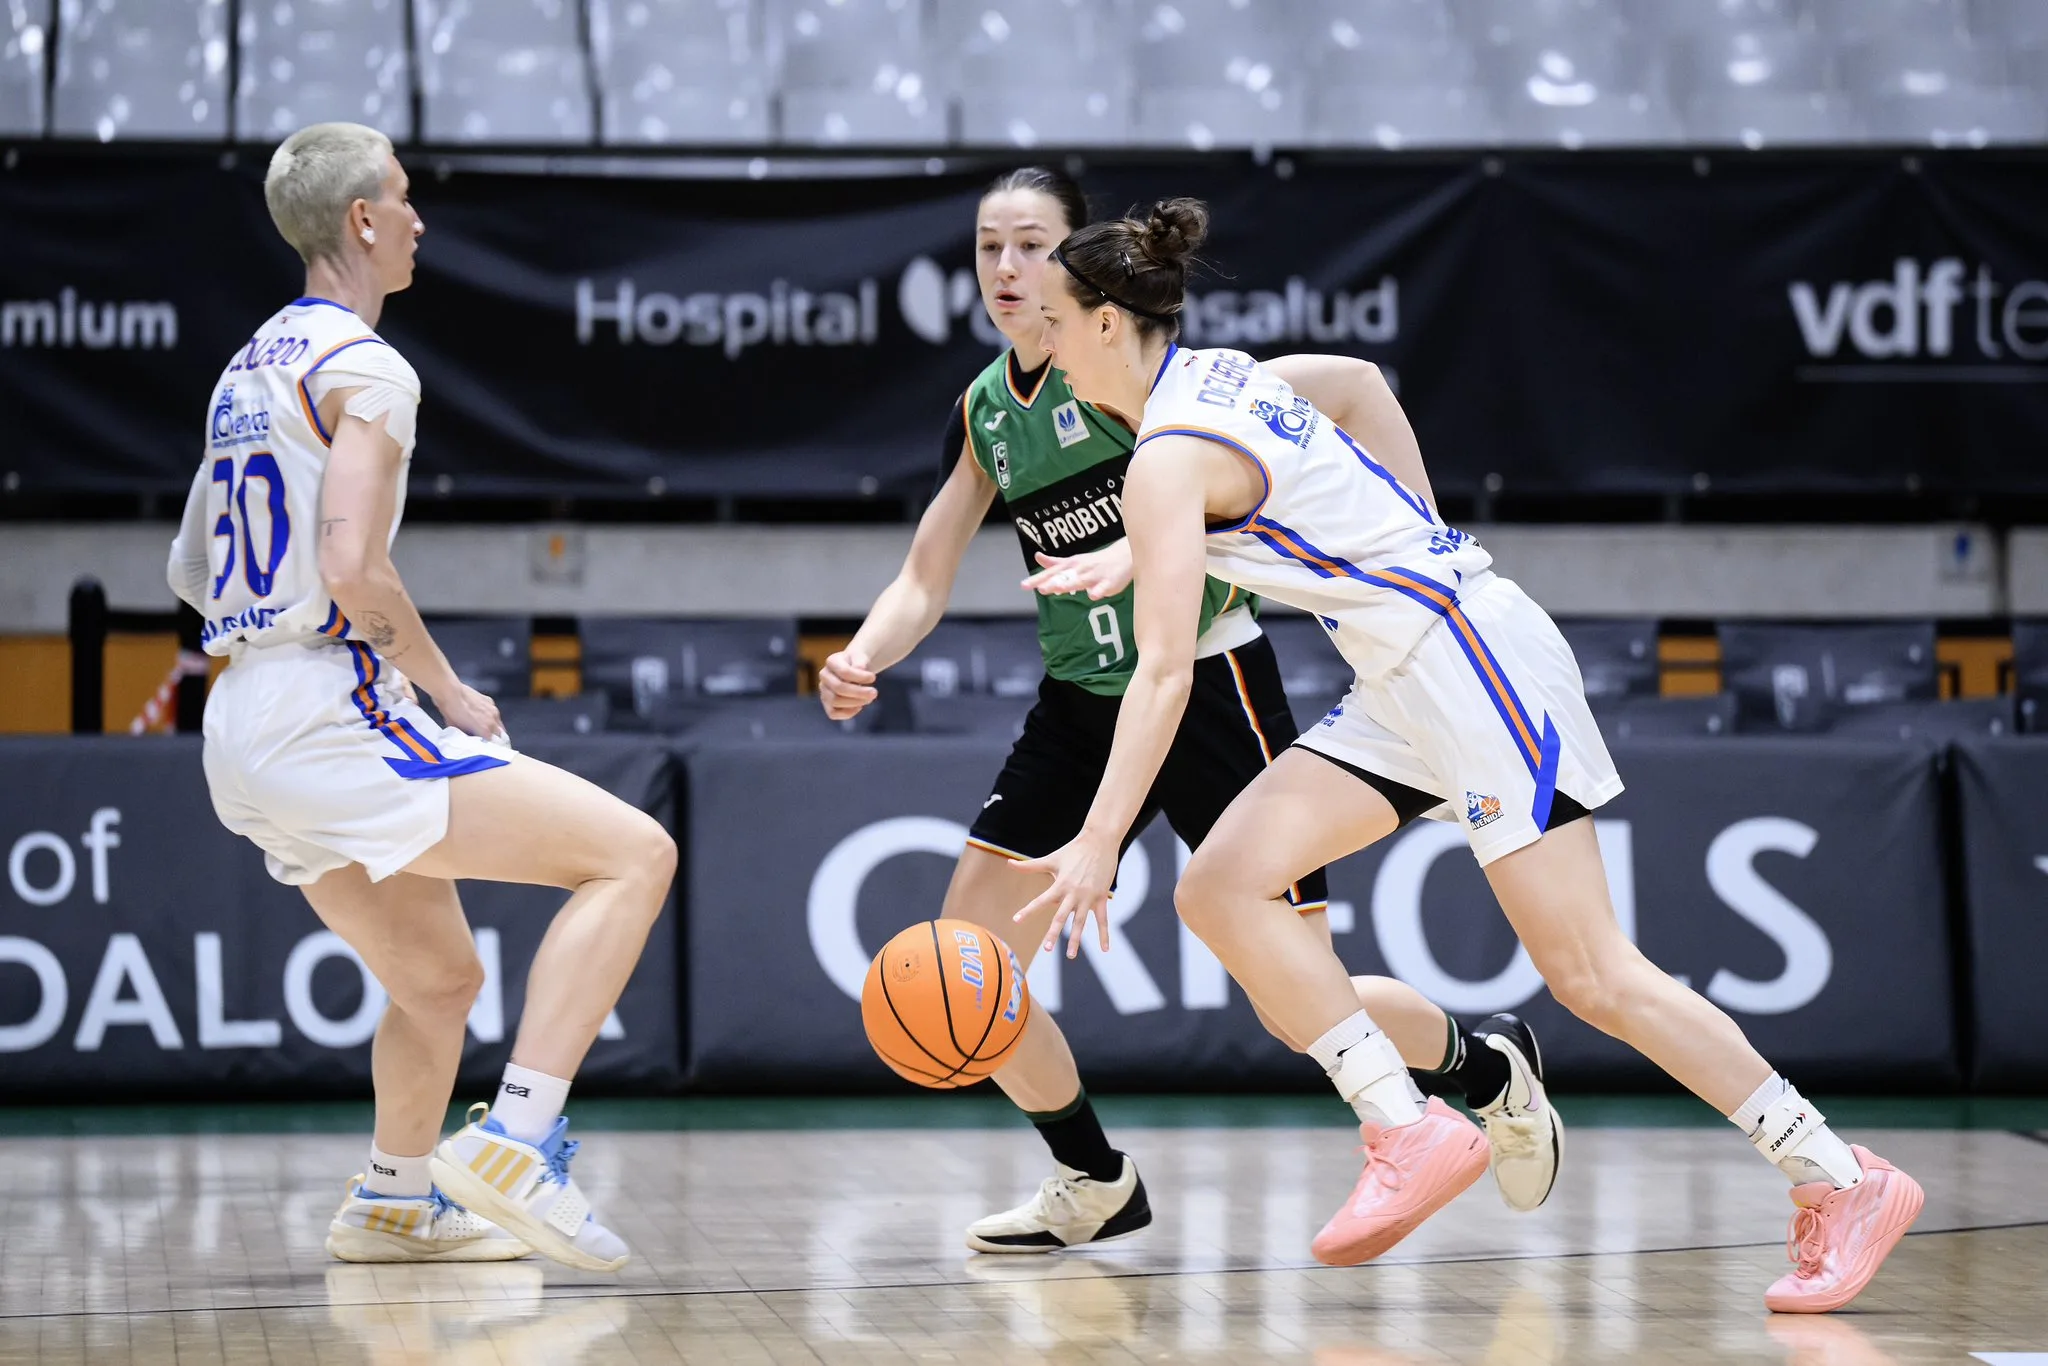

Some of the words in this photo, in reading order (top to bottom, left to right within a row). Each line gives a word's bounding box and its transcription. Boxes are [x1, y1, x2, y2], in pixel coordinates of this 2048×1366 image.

[575, 277, 878, 360] Hospital
[212, 452, 290, 600] 30
[1088, 604, 1124, 669] 9
[8, 807, 121, 905] of
[1471, 808, 1504, 830] AVENIDA
[954, 930, 984, 989] EVO
